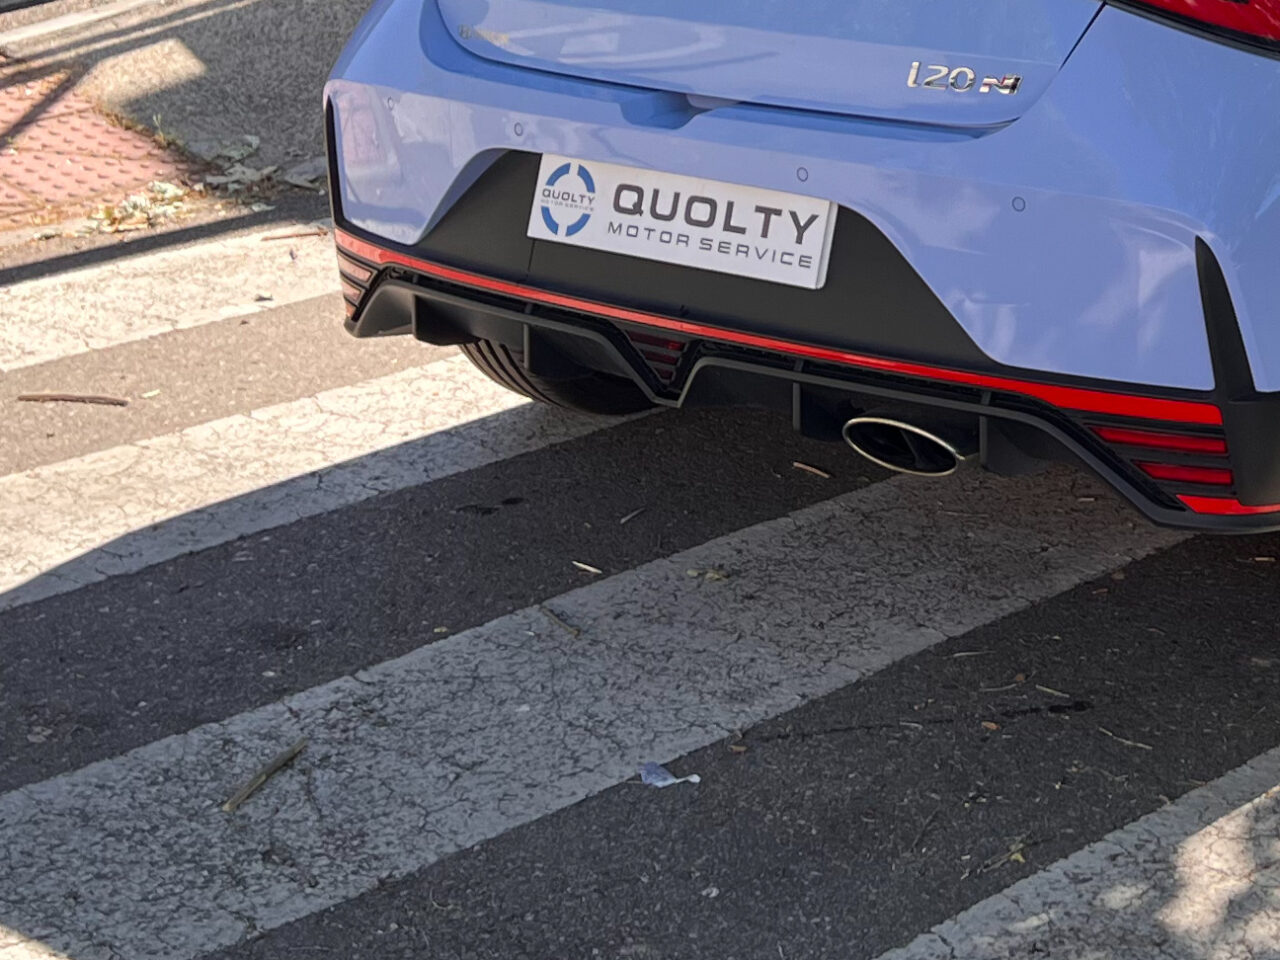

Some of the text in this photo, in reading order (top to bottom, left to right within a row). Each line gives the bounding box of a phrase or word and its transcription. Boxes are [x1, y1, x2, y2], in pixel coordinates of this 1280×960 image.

[907, 61, 976, 93] i20
[542, 188, 596, 205] QUOLTY
[613, 183, 819, 245] QUOLTY
[608, 221, 813, 269] MOTOR SERVICE
